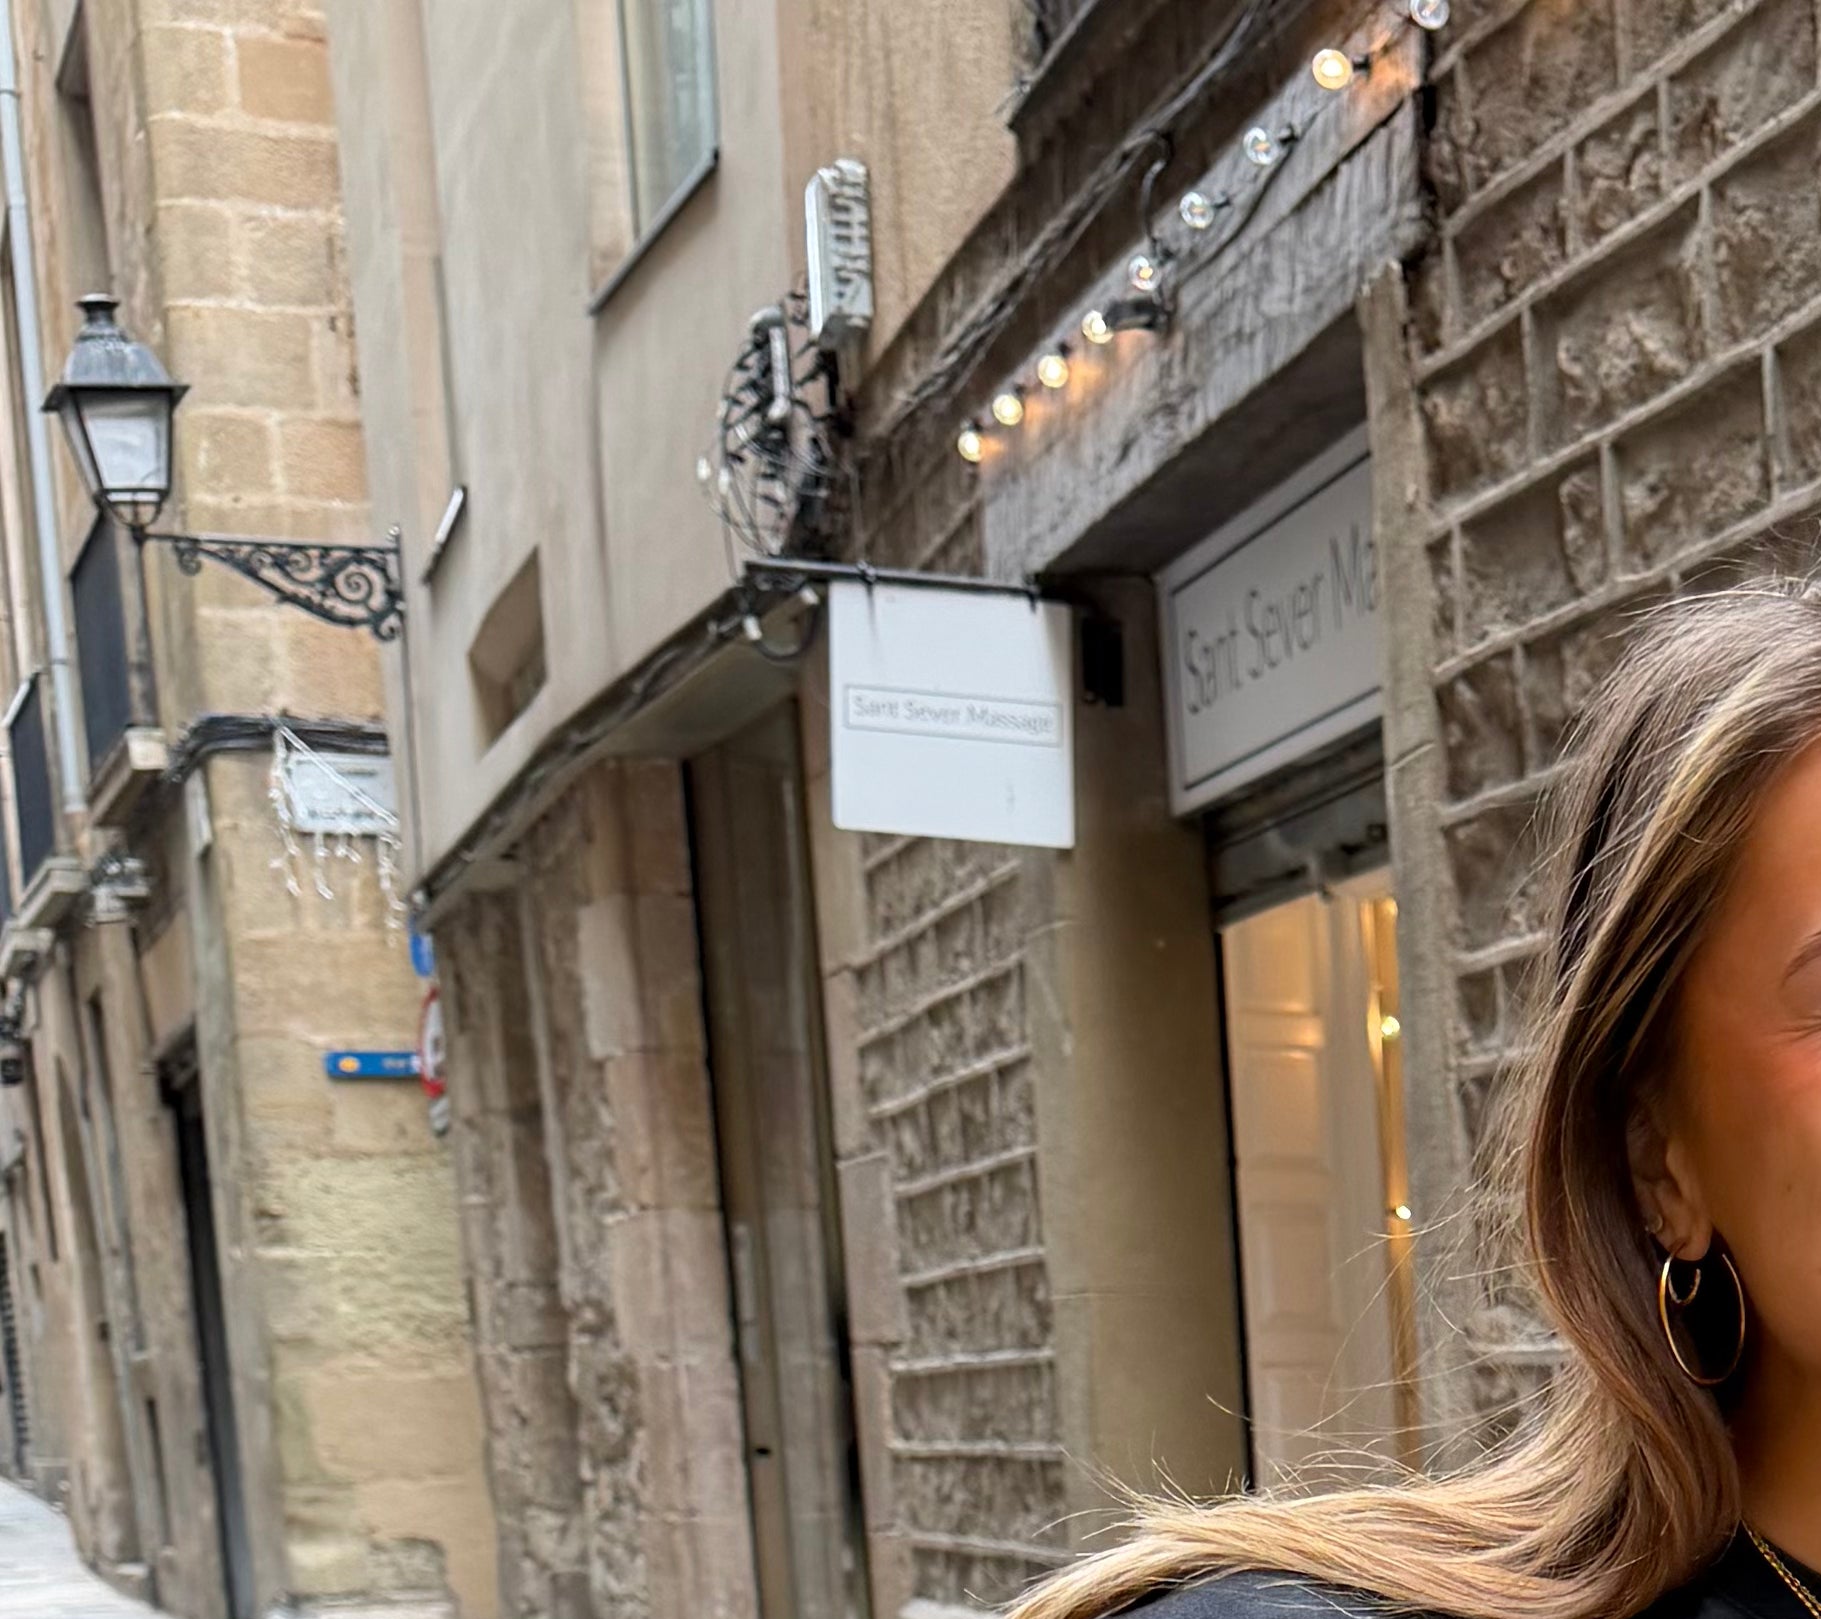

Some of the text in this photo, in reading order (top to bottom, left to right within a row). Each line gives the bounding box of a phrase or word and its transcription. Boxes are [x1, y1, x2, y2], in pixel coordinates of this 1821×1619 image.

[1183, 607, 1242, 717] Sant
[1243, 571, 1324, 681] Sever
[852, 695, 1054, 735] Sant Sever Massage
